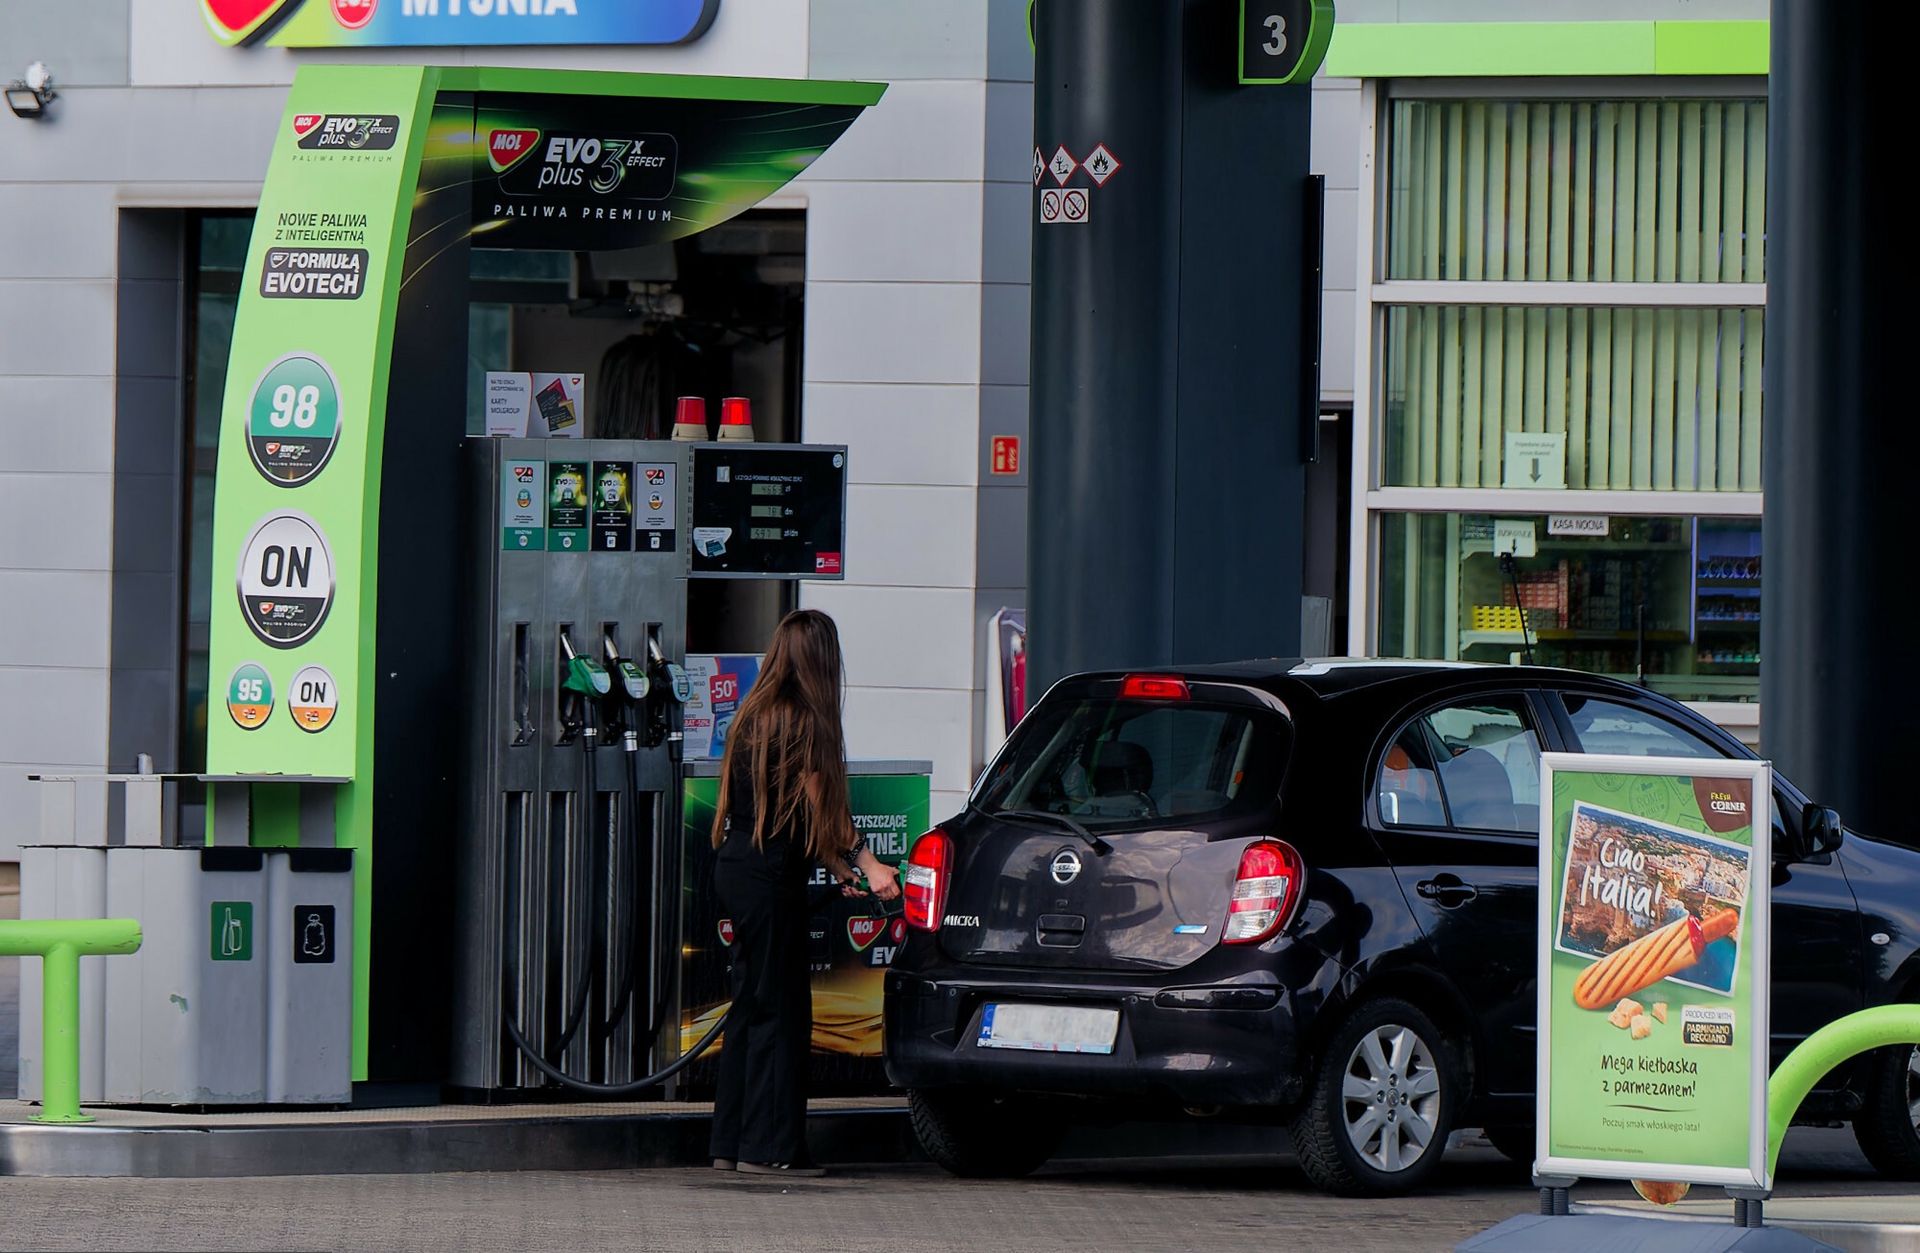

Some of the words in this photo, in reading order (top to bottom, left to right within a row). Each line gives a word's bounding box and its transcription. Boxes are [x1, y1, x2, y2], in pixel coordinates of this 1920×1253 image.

[1263, 15, 1287, 56] 3
[324, 118, 357, 133] EVO
[318, 131, 346, 146] plus
[493, 134, 522, 150] MOL
[546, 138, 601, 164] EVO
[627, 157, 666, 167] EFFECT
[538, 162, 584, 189] plus
[278, 213, 318, 226] NOWE
[321, 214, 367, 227] PALIWA
[494, 205, 568, 218] PALIWA
[583, 207, 672, 221] PREMIUM
[275, 230, 283, 240] Z
[286, 230, 364, 245] INTELIGENTNĄ
[288, 253, 360, 273] FORMUŁĄ
[265, 272, 360, 294] EVOTECH
[270, 385, 320, 428] 98
[1553, 520, 1574, 530] KASA
[1576, 520, 1605, 531] NOCNA
[261, 545, 312, 588] ON
[238, 679, 263, 701] 95
[301, 682, 326, 703] ON
[711, 680, 738, 699] -50%
[1711, 792, 1731, 801] FRESH
[1711, 801, 1746, 812] CORNER
[867, 833, 907, 855] TNEJ
[1600, 838, 1645, 873] Ciao
[1580, 865, 1663, 918] Italia!
[852, 922, 874, 934] MOL
[944, 916, 980, 927] MICRA
[872, 947, 896, 965] EV
[1686, 1010, 1715, 1020] PRODUCED
[1687, 1024, 1730, 1034] PARMIGIANO
[1691, 1033, 1727, 1044] REGGIANO
[1602, 1055, 1634, 1075] Mega
[1639, 1056, 1698, 1075] kiełbaska
[1603, 1081, 1609, 1092] z
[1615, 1081, 1696, 1098] parmezanem!
[1603, 1118, 1625, 1129] Poczuj
[1626, 1120, 1644, 1129] smak
[1647, 1121, 1683, 1132] włoskiego
[1684, 1123, 1700, 1132] lata!
